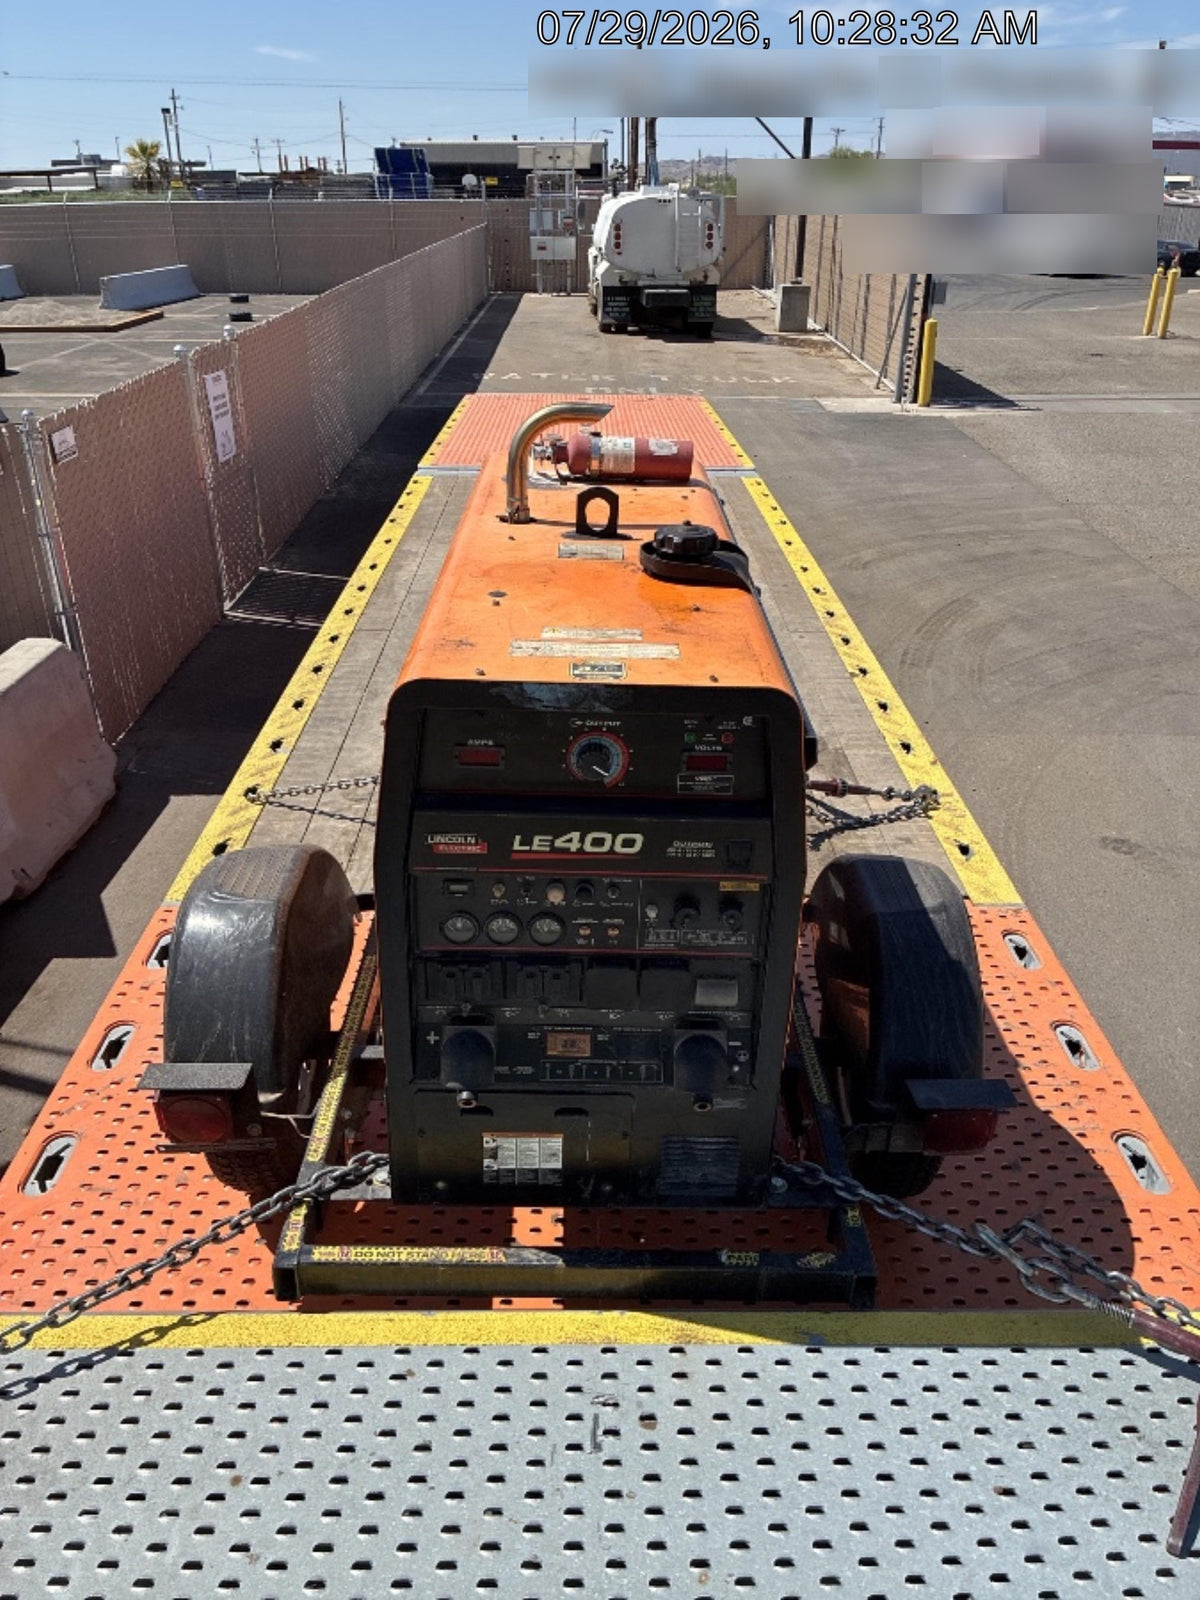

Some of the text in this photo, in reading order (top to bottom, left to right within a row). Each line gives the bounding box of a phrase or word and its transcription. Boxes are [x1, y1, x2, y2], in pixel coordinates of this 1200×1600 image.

[428, 834, 476, 844] LINCOLN
[511, 831, 644, 854] LE400
[354, 1251, 373, 1259] DO
[377, 1251, 403, 1259] NOT
